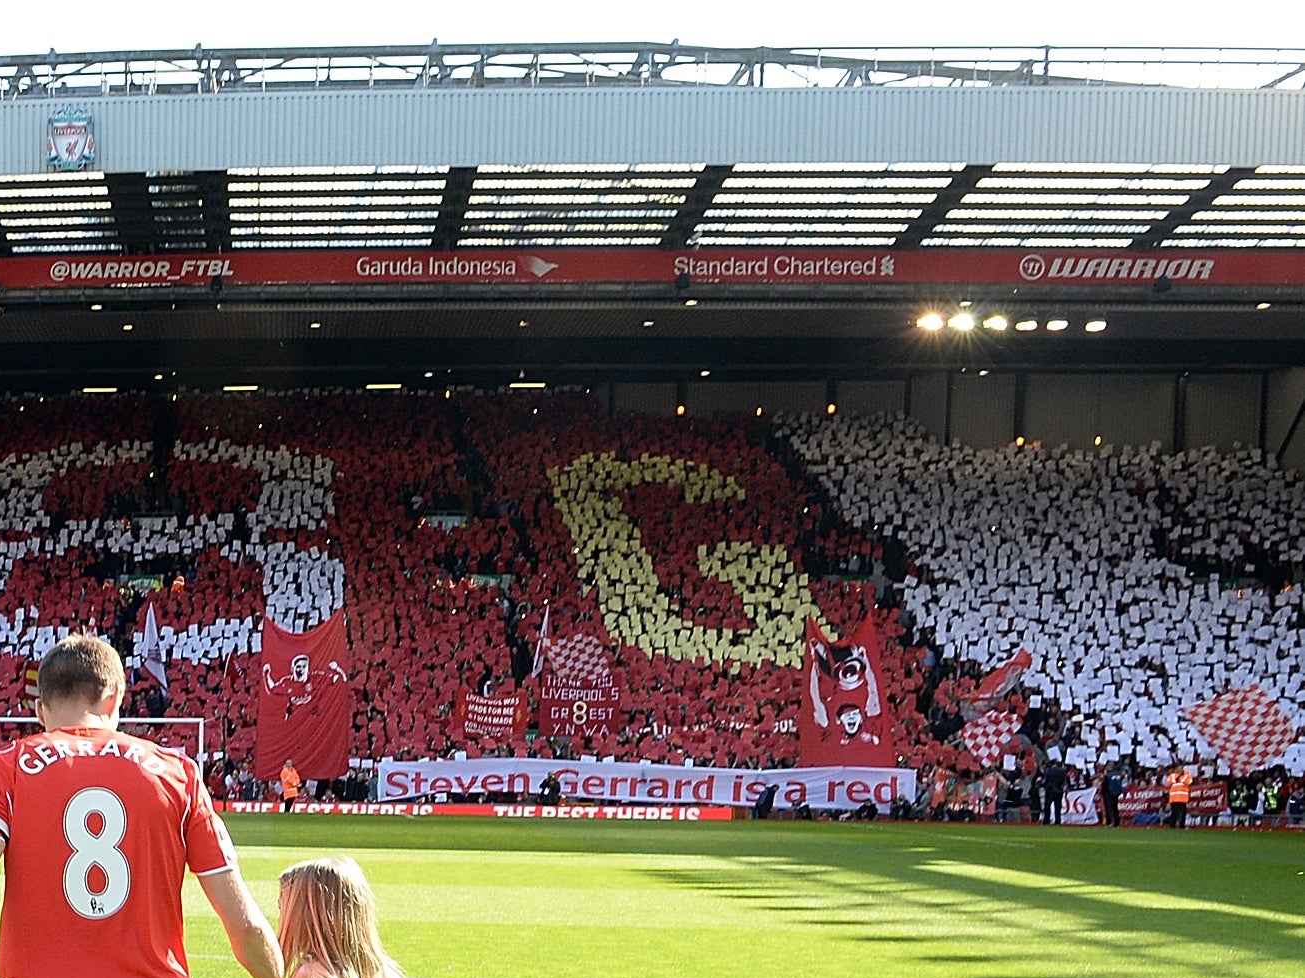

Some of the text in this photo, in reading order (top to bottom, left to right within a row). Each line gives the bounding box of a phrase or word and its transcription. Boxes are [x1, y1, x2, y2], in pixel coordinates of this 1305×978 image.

[49, 259, 234, 280] @WARRIOR_FTBL
[356, 257, 517, 277] Garuda Indonesia
[674, 256, 877, 276] Standard Chartered
[1048, 258, 1215, 280] WARRIOR
[549, 451, 836, 669] G
[17, 738, 167, 776] GERRARD
[385, 768, 899, 805] Steven Gerrard is a red
[62, 785, 132, 920] 8
